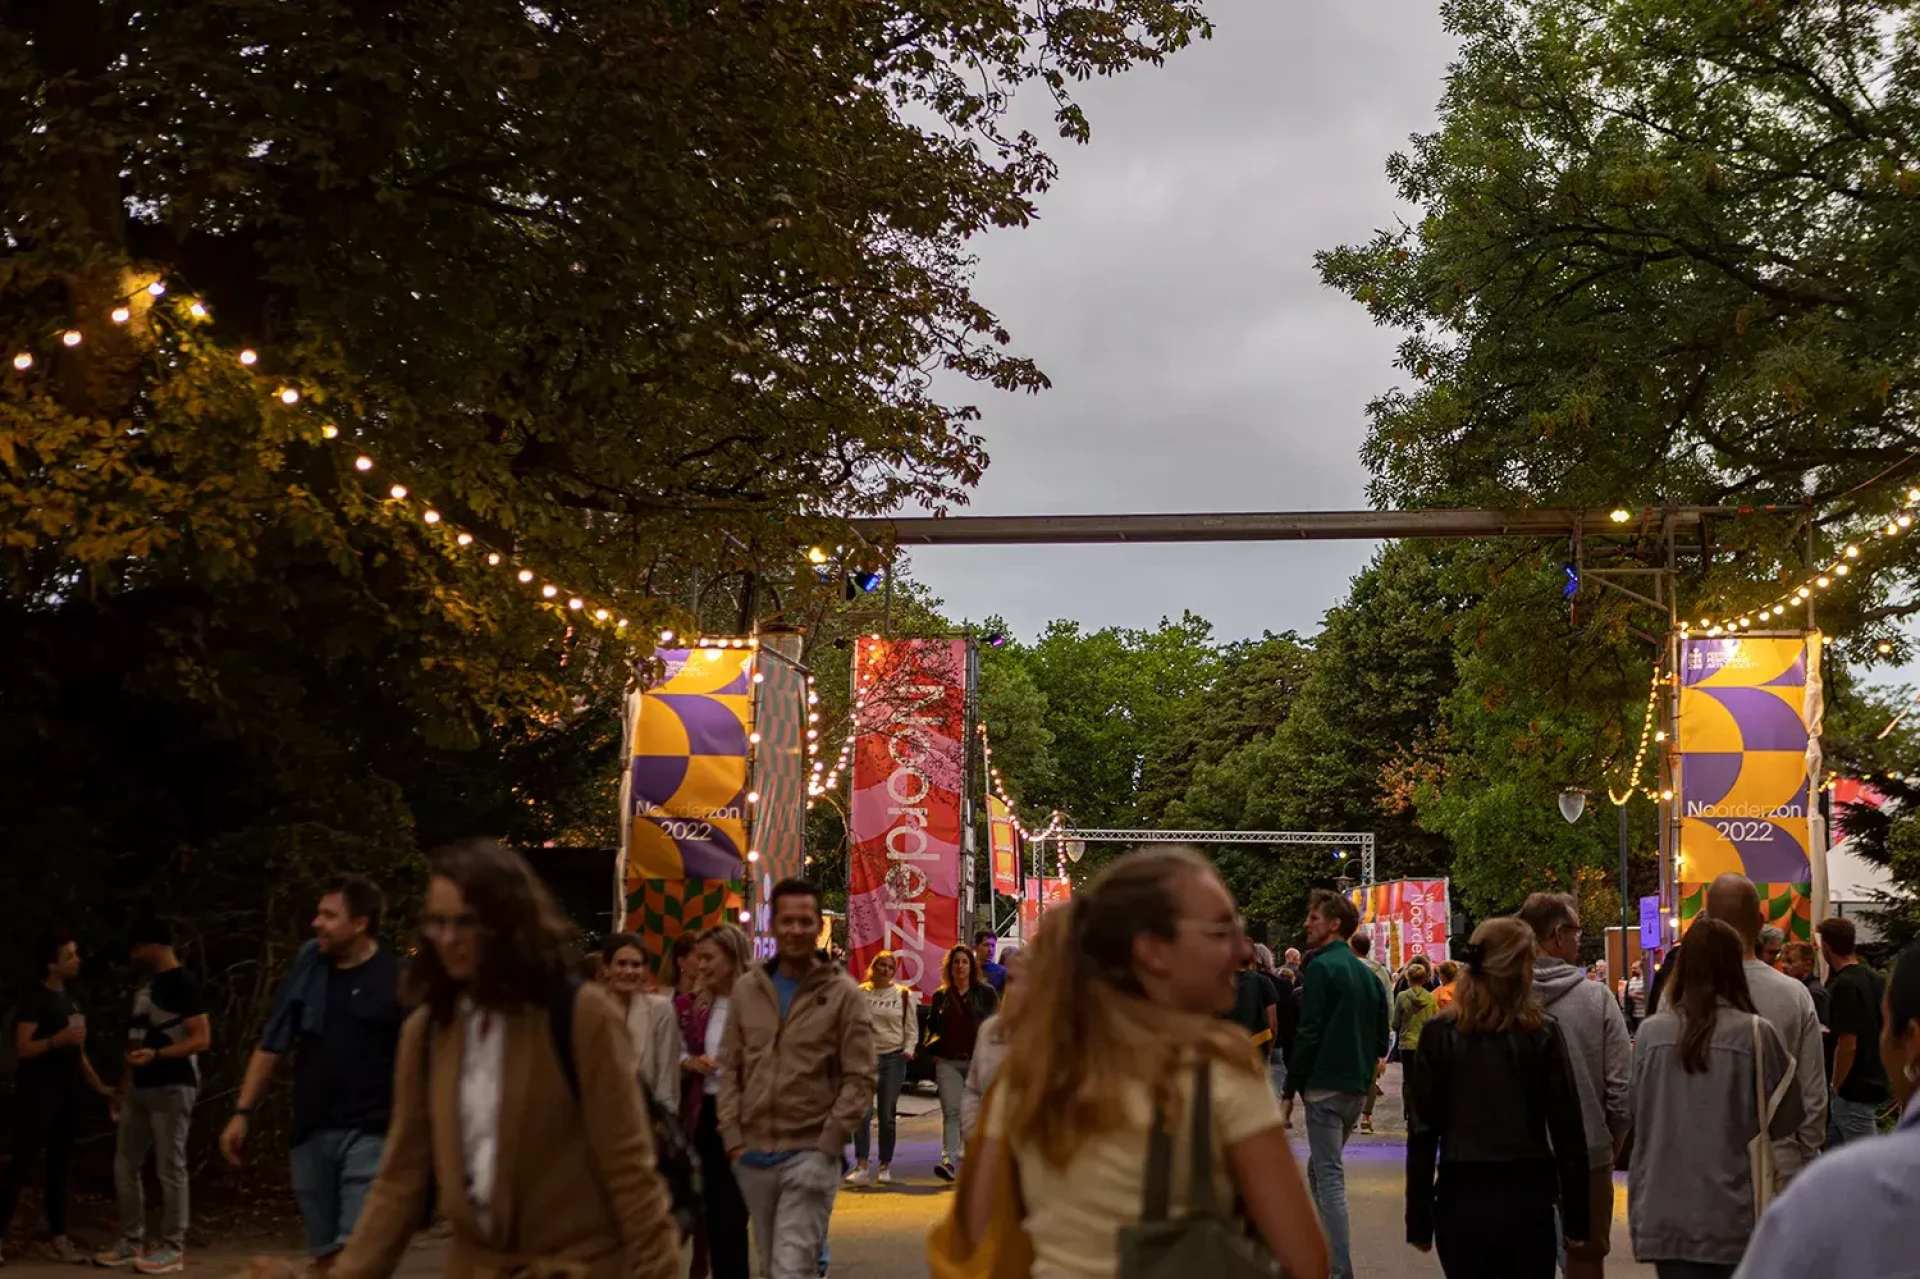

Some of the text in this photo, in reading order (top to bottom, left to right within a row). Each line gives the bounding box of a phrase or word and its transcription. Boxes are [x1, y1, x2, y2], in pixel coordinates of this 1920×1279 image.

[635, 800, 740, 820] Noorderzon
[1687, 800, 1801, 818] Noorderzon
[660, 821, 712, 841] 2022
[1716, 821, 1774, 842] 2022
[885, 684, 944, 1003] Noorderzo
